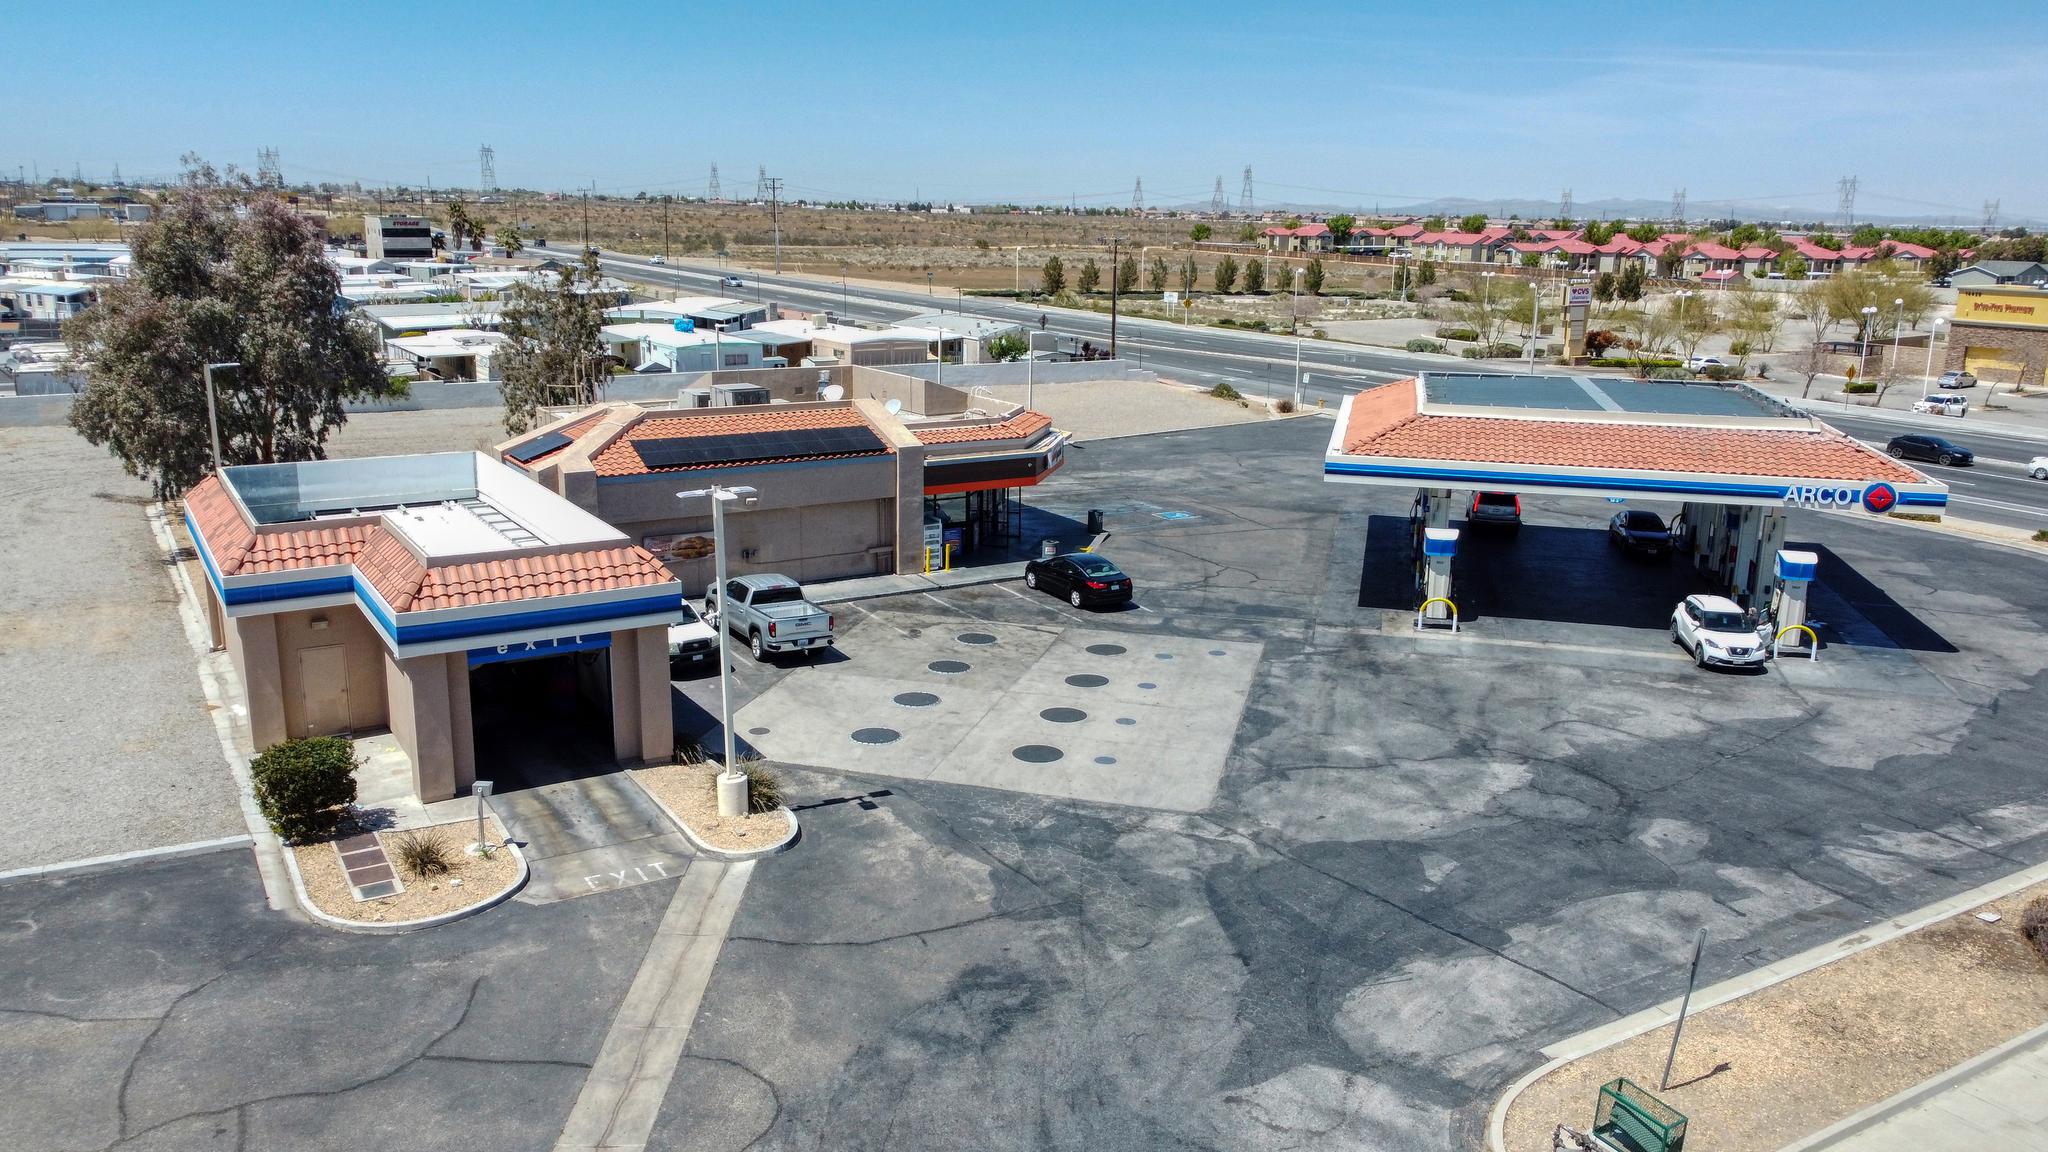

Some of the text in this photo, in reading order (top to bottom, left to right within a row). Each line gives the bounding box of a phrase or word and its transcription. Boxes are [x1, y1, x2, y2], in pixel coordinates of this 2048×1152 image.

[1784, 485, 1852, 505] ARCO
[497, 634, 583, 655] exit
[584, 862, 667, 888] EXIT
